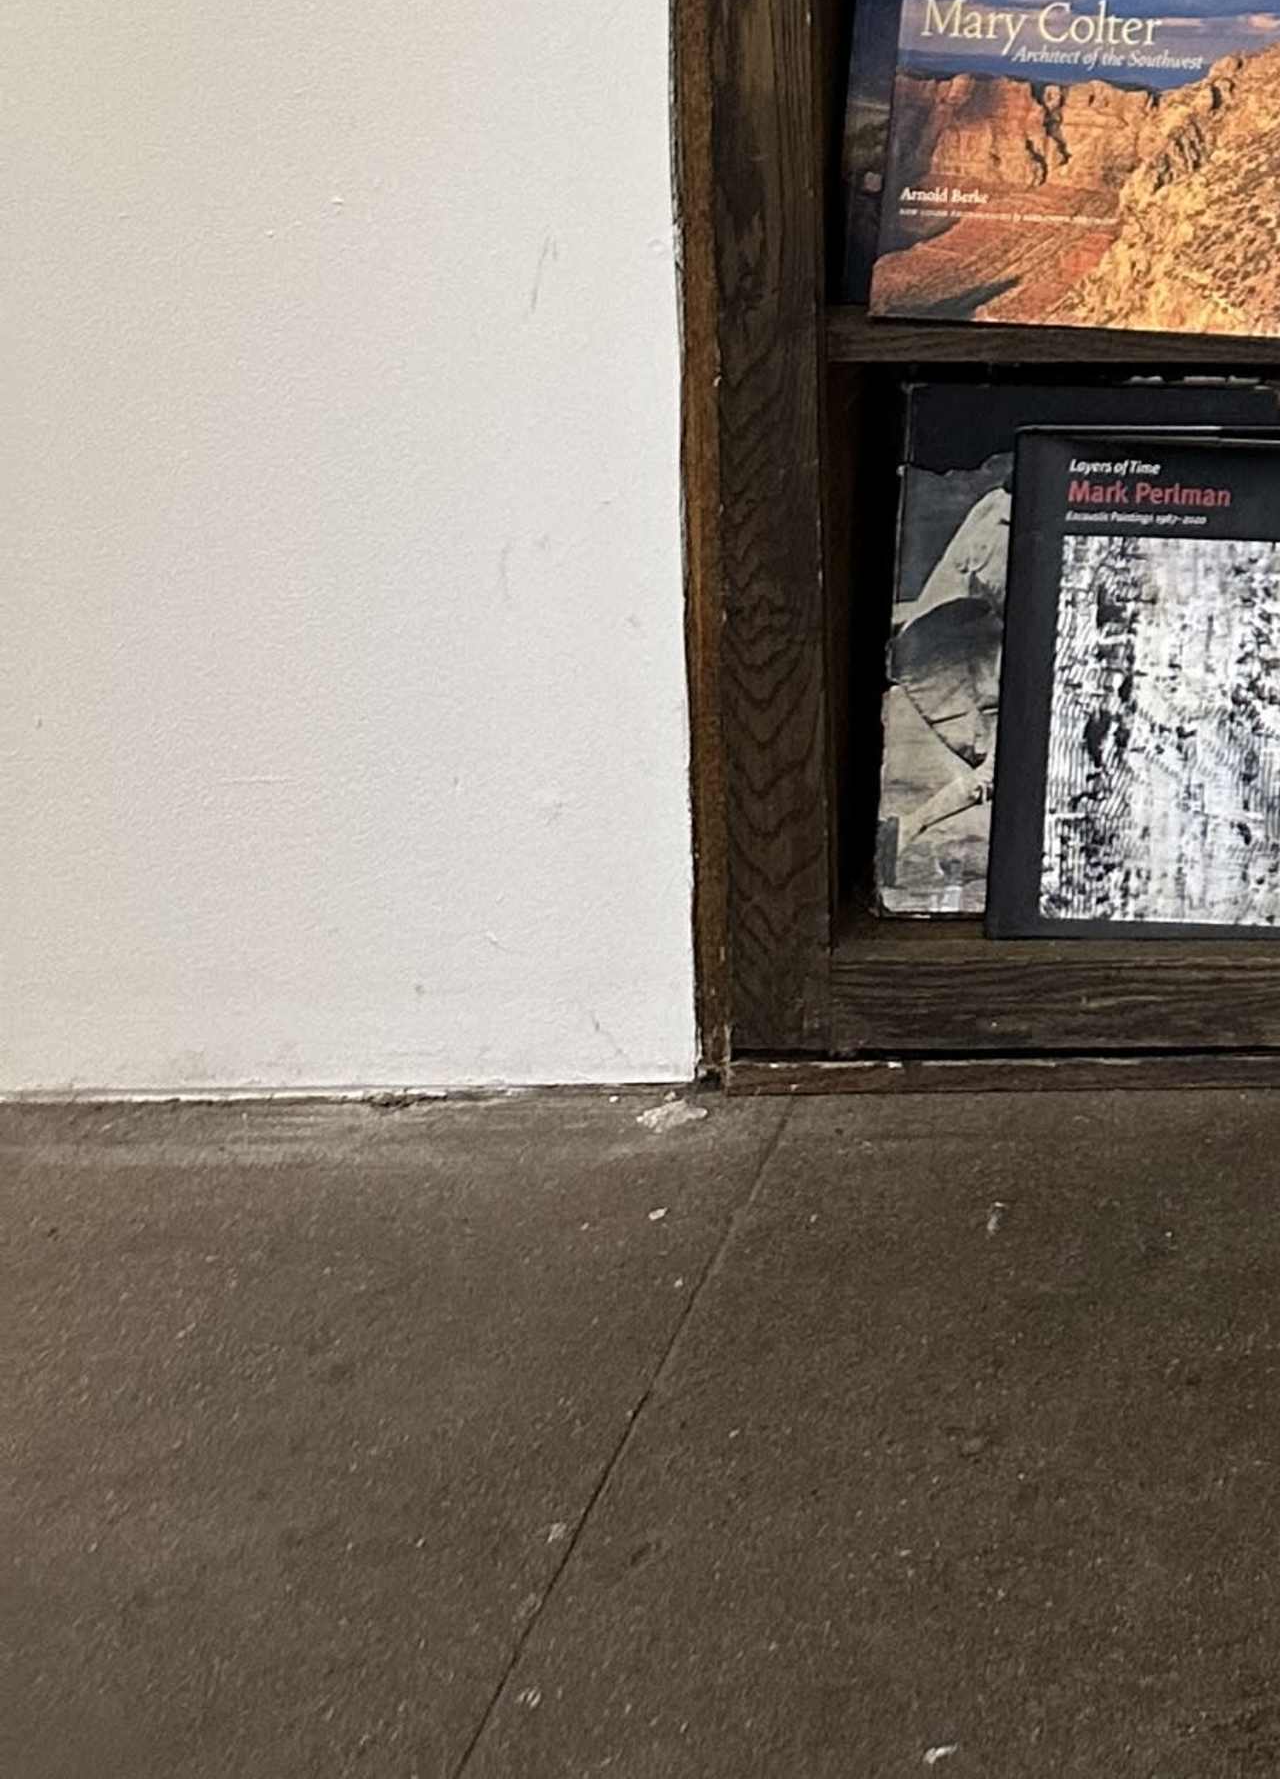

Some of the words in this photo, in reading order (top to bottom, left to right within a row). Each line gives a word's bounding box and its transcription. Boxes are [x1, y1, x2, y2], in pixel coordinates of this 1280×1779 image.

[1039, 0, 1163, 46] Colter
[1012, 45, 1080, 64] Architect
[1082, 47, 1100, 71] of
[1102, 48, 1124, 66] the
[1128, 49, 1204, 72] Southwest
[900, 187, 948, 203] Arnold
[951, 188, 988, 204] Berke
[1069, 458, 1112, 476] Layers
[1113, 459, 1128, 475] of
[1129, 460, 1161, 475] Time
[1068, 480, 1130, 504] Mark
[1135, 483, 1232, 507] Perlman
